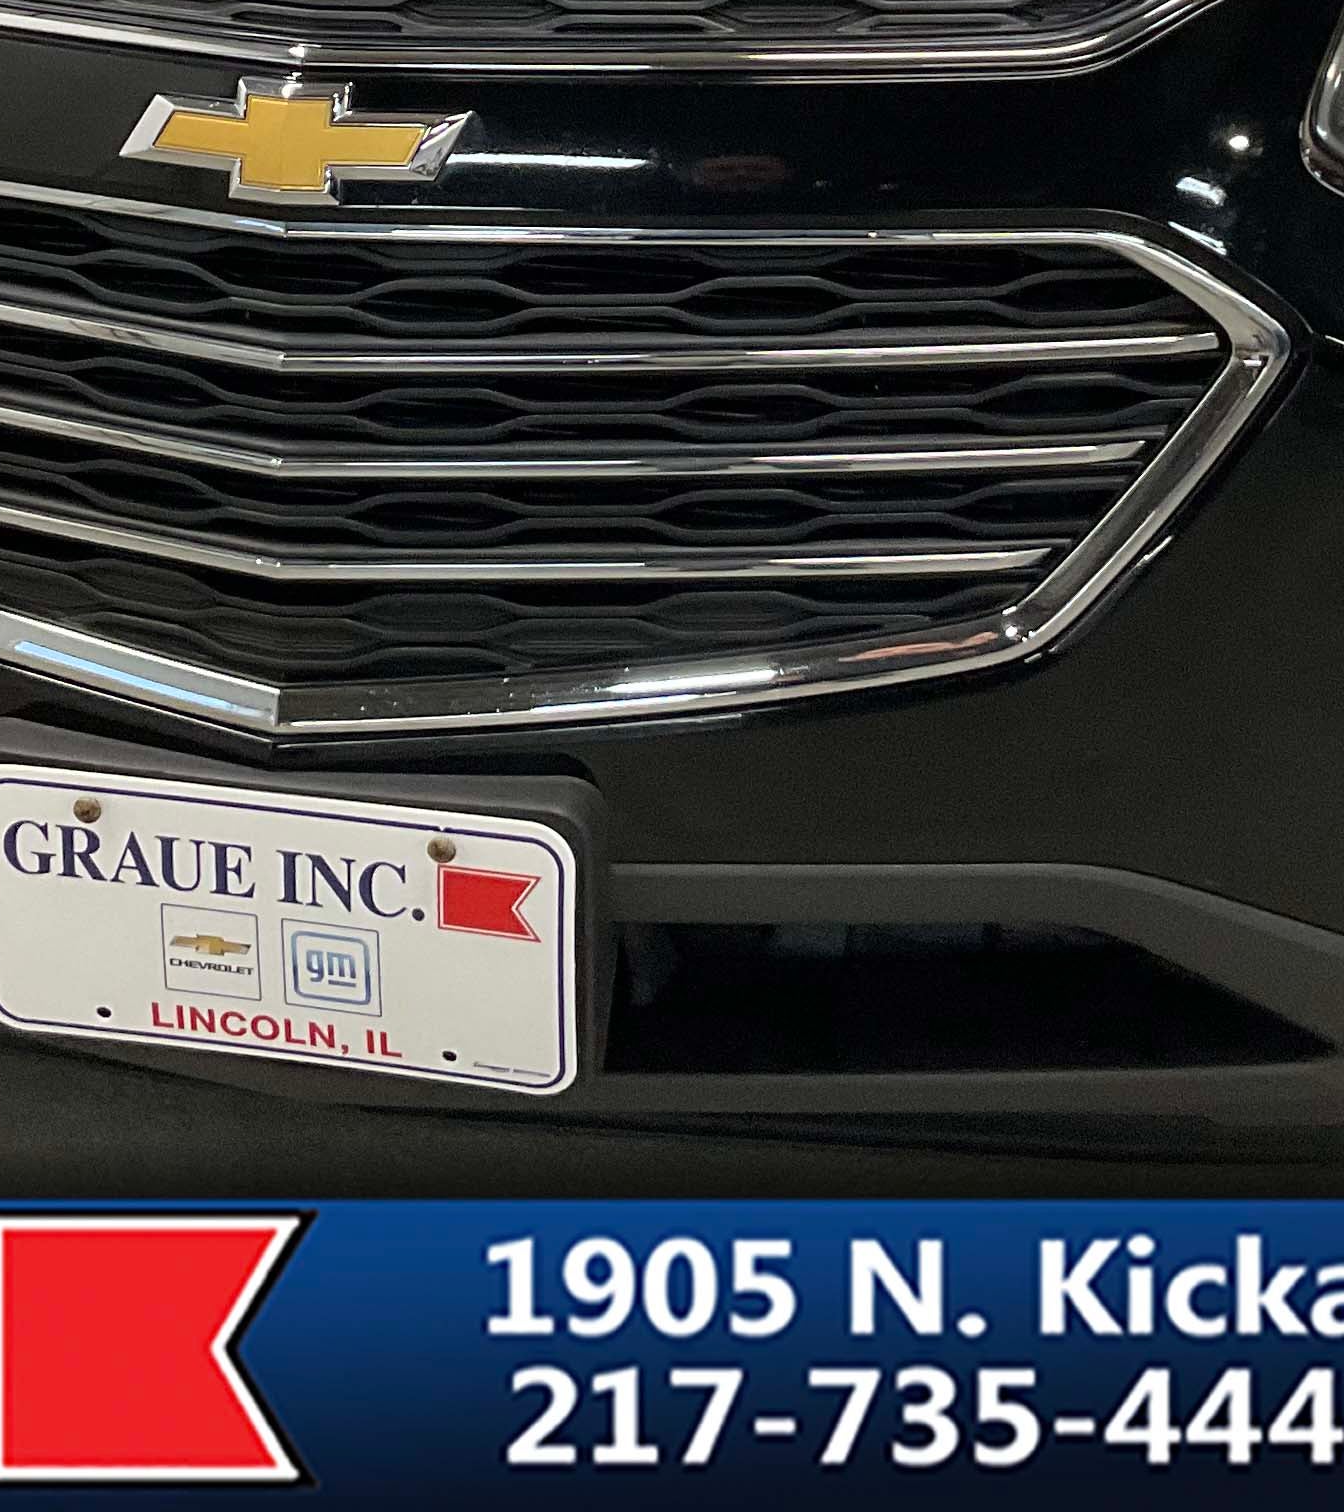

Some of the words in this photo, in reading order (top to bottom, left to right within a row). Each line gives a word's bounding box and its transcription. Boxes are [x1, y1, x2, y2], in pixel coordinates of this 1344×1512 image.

[2, 819, 256, 898] GRAUE
[276, 849, 426, 922] INC.
[169, 957, 255, 976] CHEVROLET
[151, 1001, 350, 1055] LINCOLN,
[366, 1029, 403, 1058] IL
